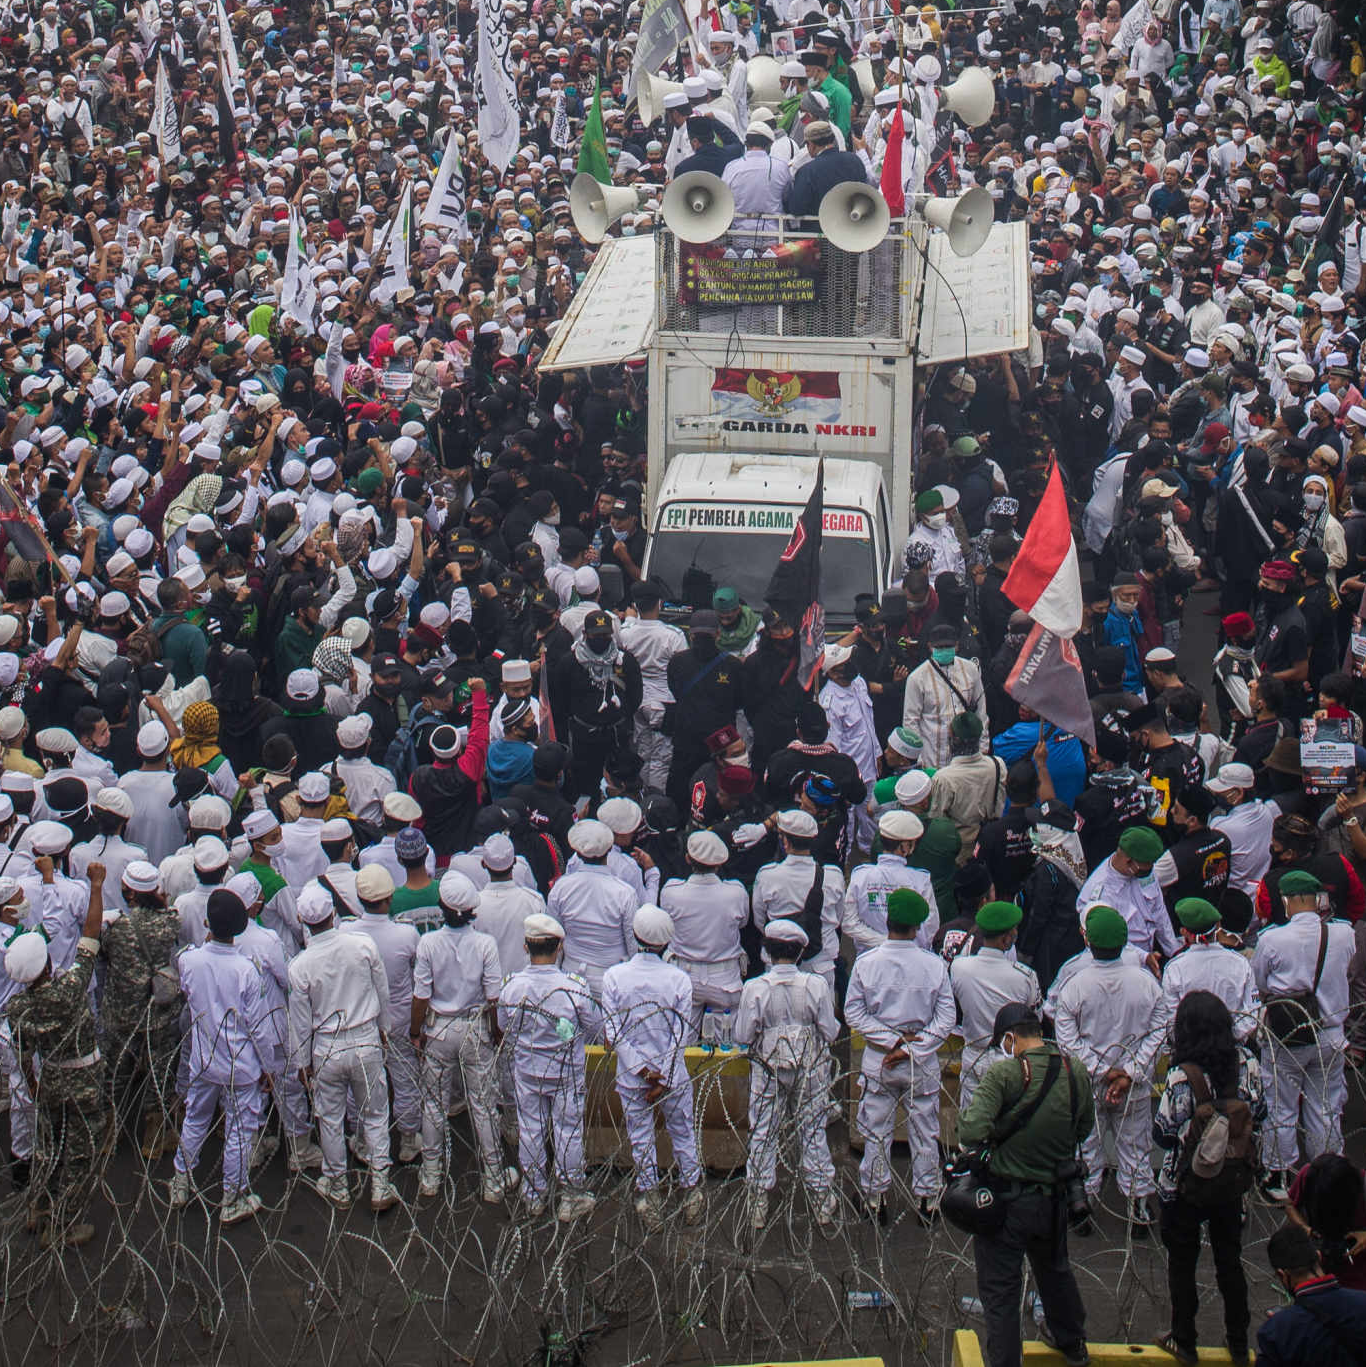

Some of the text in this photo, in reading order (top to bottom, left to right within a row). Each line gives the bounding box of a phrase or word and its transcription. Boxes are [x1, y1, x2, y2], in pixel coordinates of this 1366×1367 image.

[723, 420, 809, 434] GARDA
[815, 424, 877, 437] NKRI
[667, 508, 864, 532] FPI PEMBELA AGAMA EGARA
